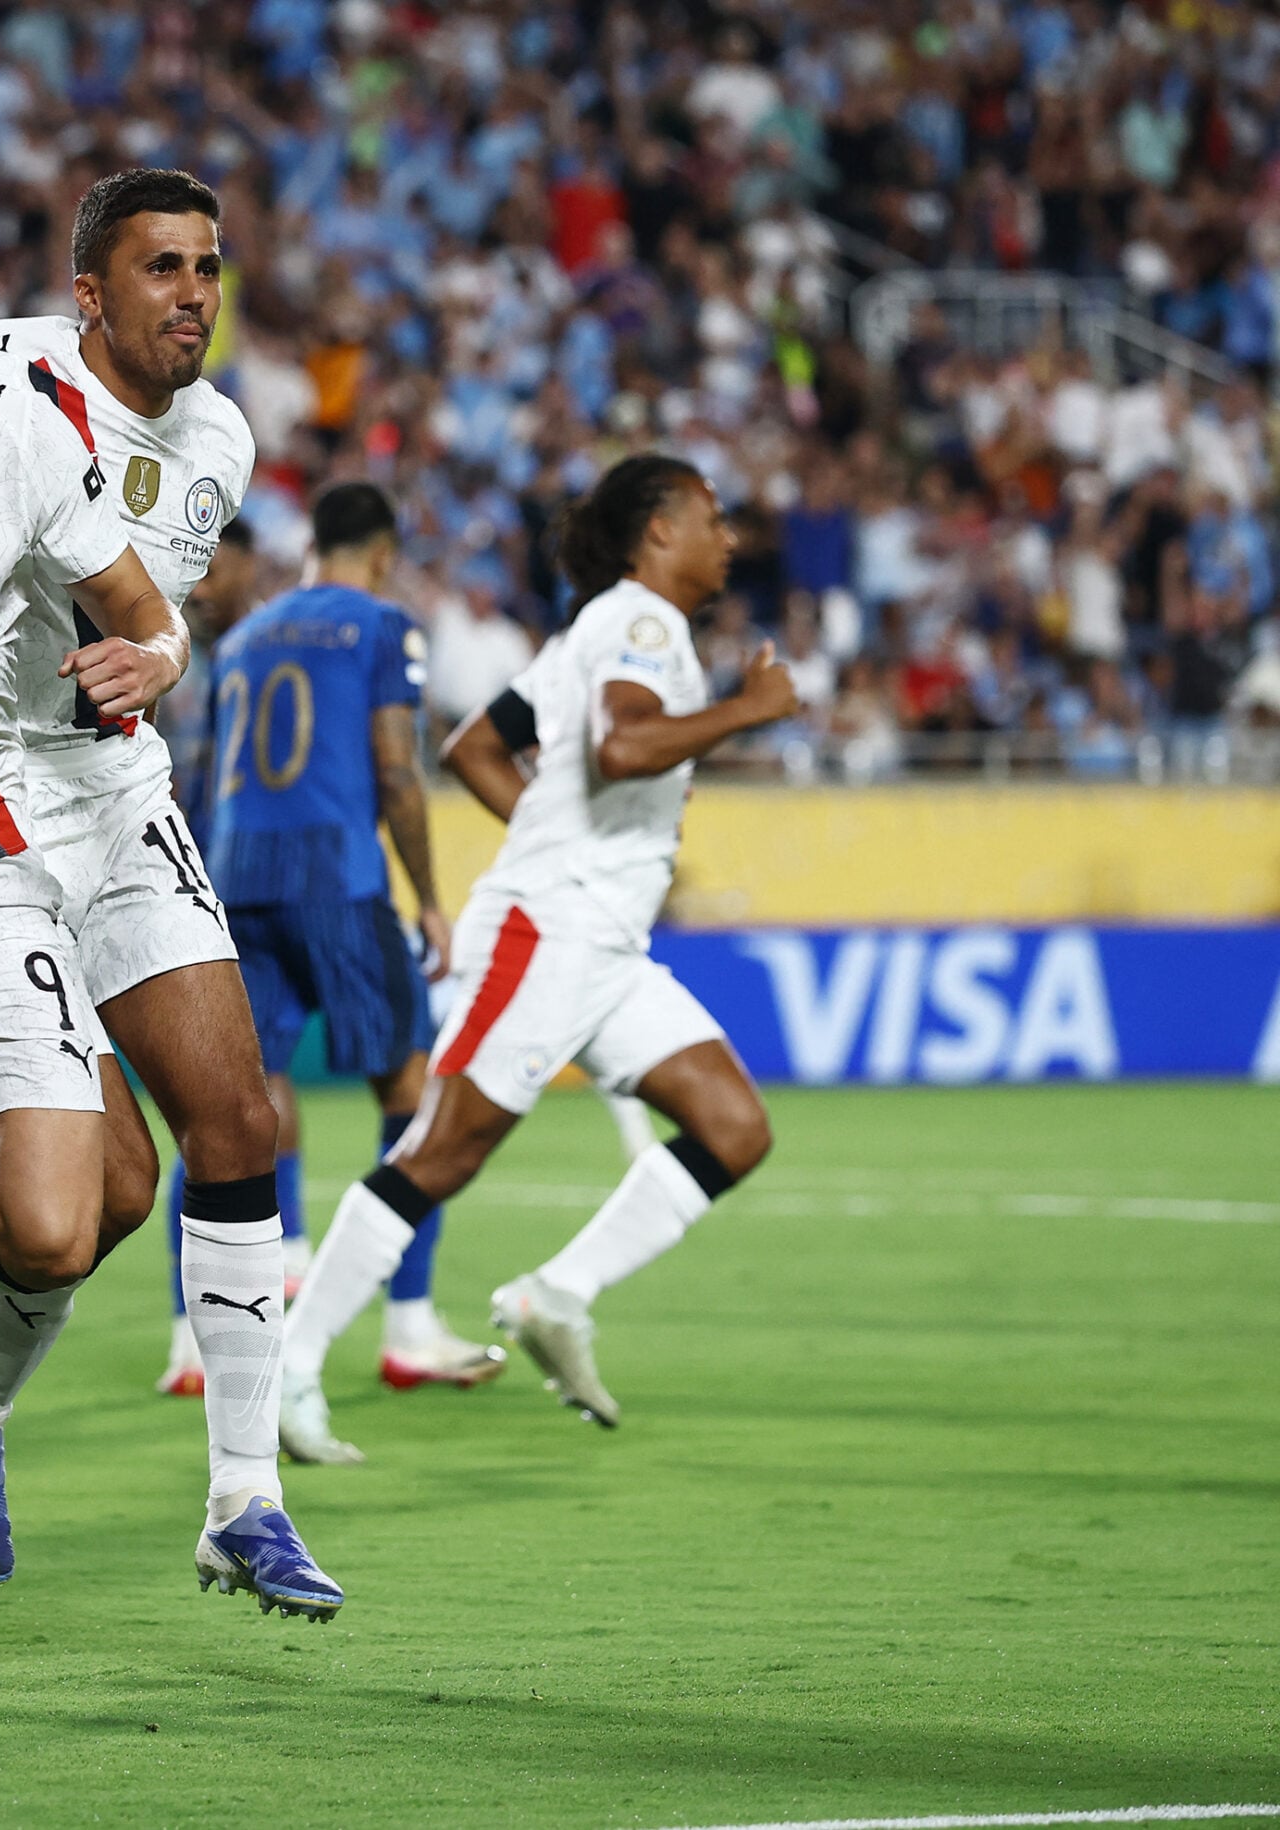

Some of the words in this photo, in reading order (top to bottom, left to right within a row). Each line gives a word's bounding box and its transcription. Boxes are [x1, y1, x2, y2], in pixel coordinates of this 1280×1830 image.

[131, 493, 148, 504] FIFA
[218, 662, 315, 800] 20
[24, 951, 75, 1031] 9
[742, 929, 1119, 1084] VISA
